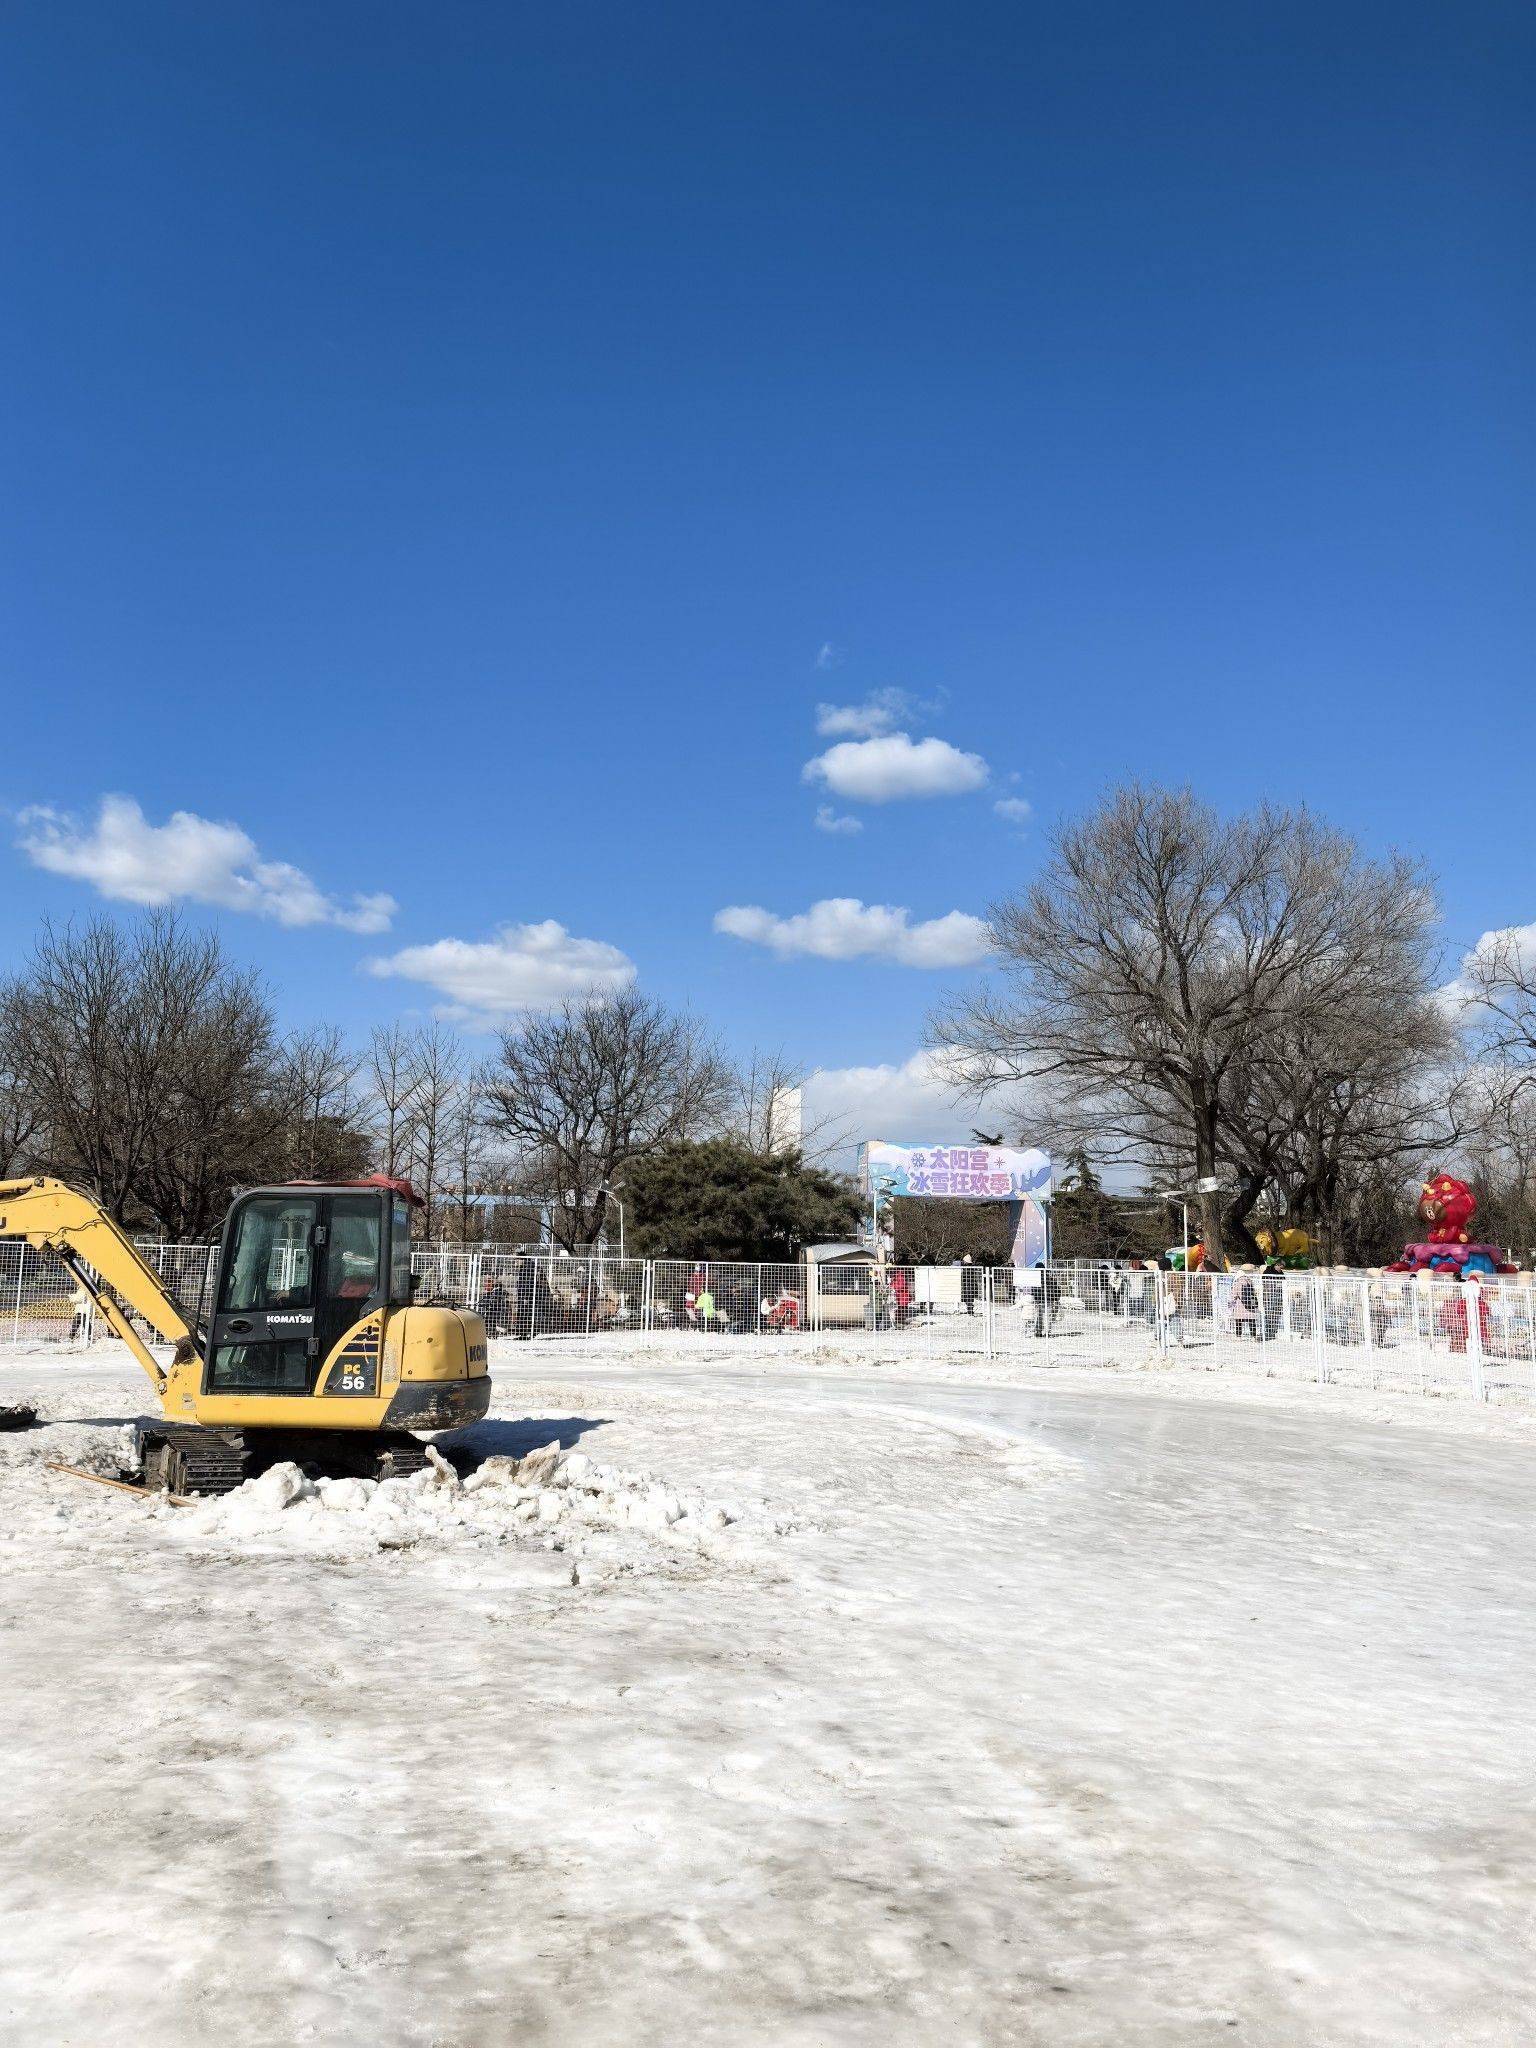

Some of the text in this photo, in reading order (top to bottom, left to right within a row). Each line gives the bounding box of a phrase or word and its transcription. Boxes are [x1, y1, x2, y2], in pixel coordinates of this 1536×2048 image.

[930, 1149, 989, 1170] 太阳宫
[910, 1172, 1010, 1194] 冰雪狂欢季
[266, 1314, 313, 1323] KOMATSU
[343, 1364, 361, 1375] PC
[341, 1376, 365, 1390] 56
